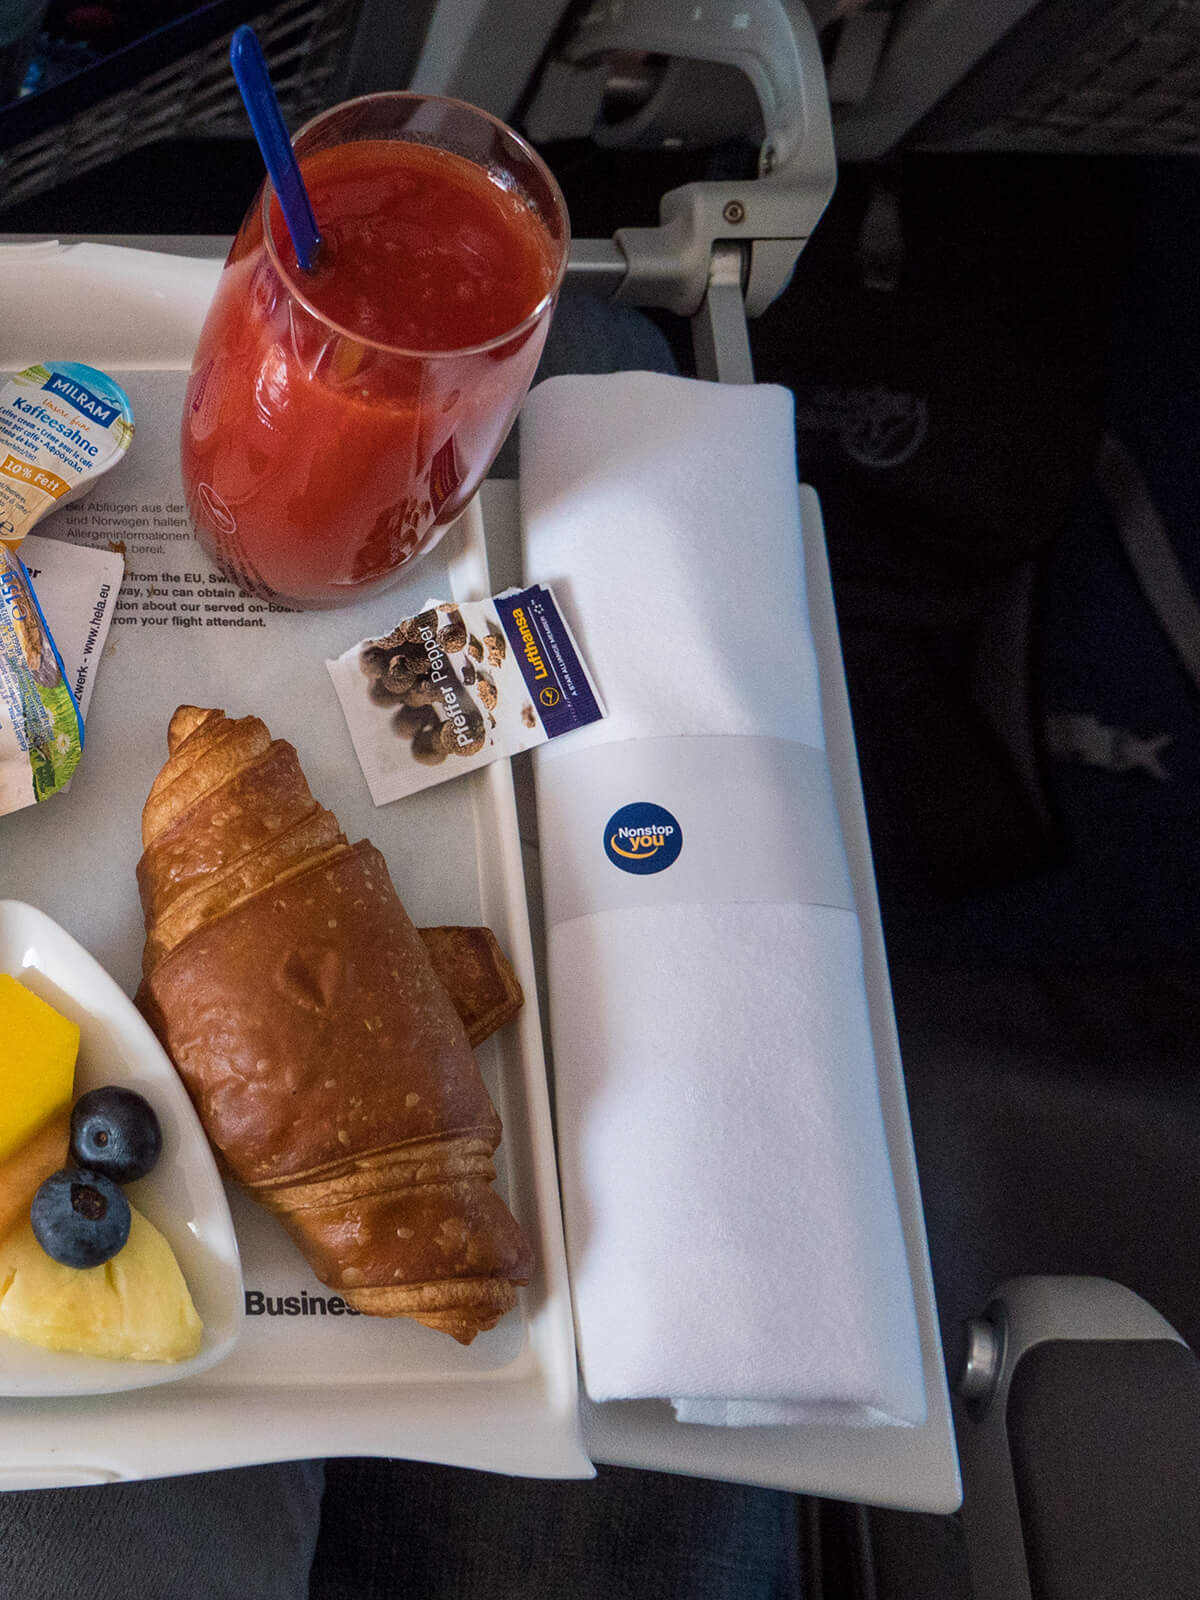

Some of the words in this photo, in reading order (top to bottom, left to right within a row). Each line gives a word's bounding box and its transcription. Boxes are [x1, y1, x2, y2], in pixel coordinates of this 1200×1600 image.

[52, 379, 111, 421] MILRAM
[12, 397, 99, 457] Kaffeesahne
[17, 415, 37, 431] cream
[34, 472, 60, 492] Fett
[141, 503, 162, 513] aus
[165, 502, 184, 513] der
[66, 516, 87, 525] und
[91, 516, 149, 528] Norwegen
[66, 528, 190, 542] Allergeninformationen
[130, 573, 158, 582] from
[161, 573, 179, 583] the
[184, 573, 205, 584] EU,
[146, 588, 169, 599] you
[171, 588, 194, 598] can
[197, 588, 235, 598] obtain
[142, 601, 177, 611] about
[180, 603, 200, 612] our
[204, 602, 245, 613] served
[83, 583, 111, 655] www.hela.eu
[141, 617, 168, 628] your
[171, 616, 203, 628] flight
[206, 617, 266, 628] attendant.
[512, 607, 549, 681] Lufthansa
[418, 624, 448, 684] Pepper
[551, 643, 568, 674] ALLIANCE
[440, 685, 474, 748] Pfeffer
[618, 824, 674, 839] Nonstop
[628, 834, 665, 852] you
